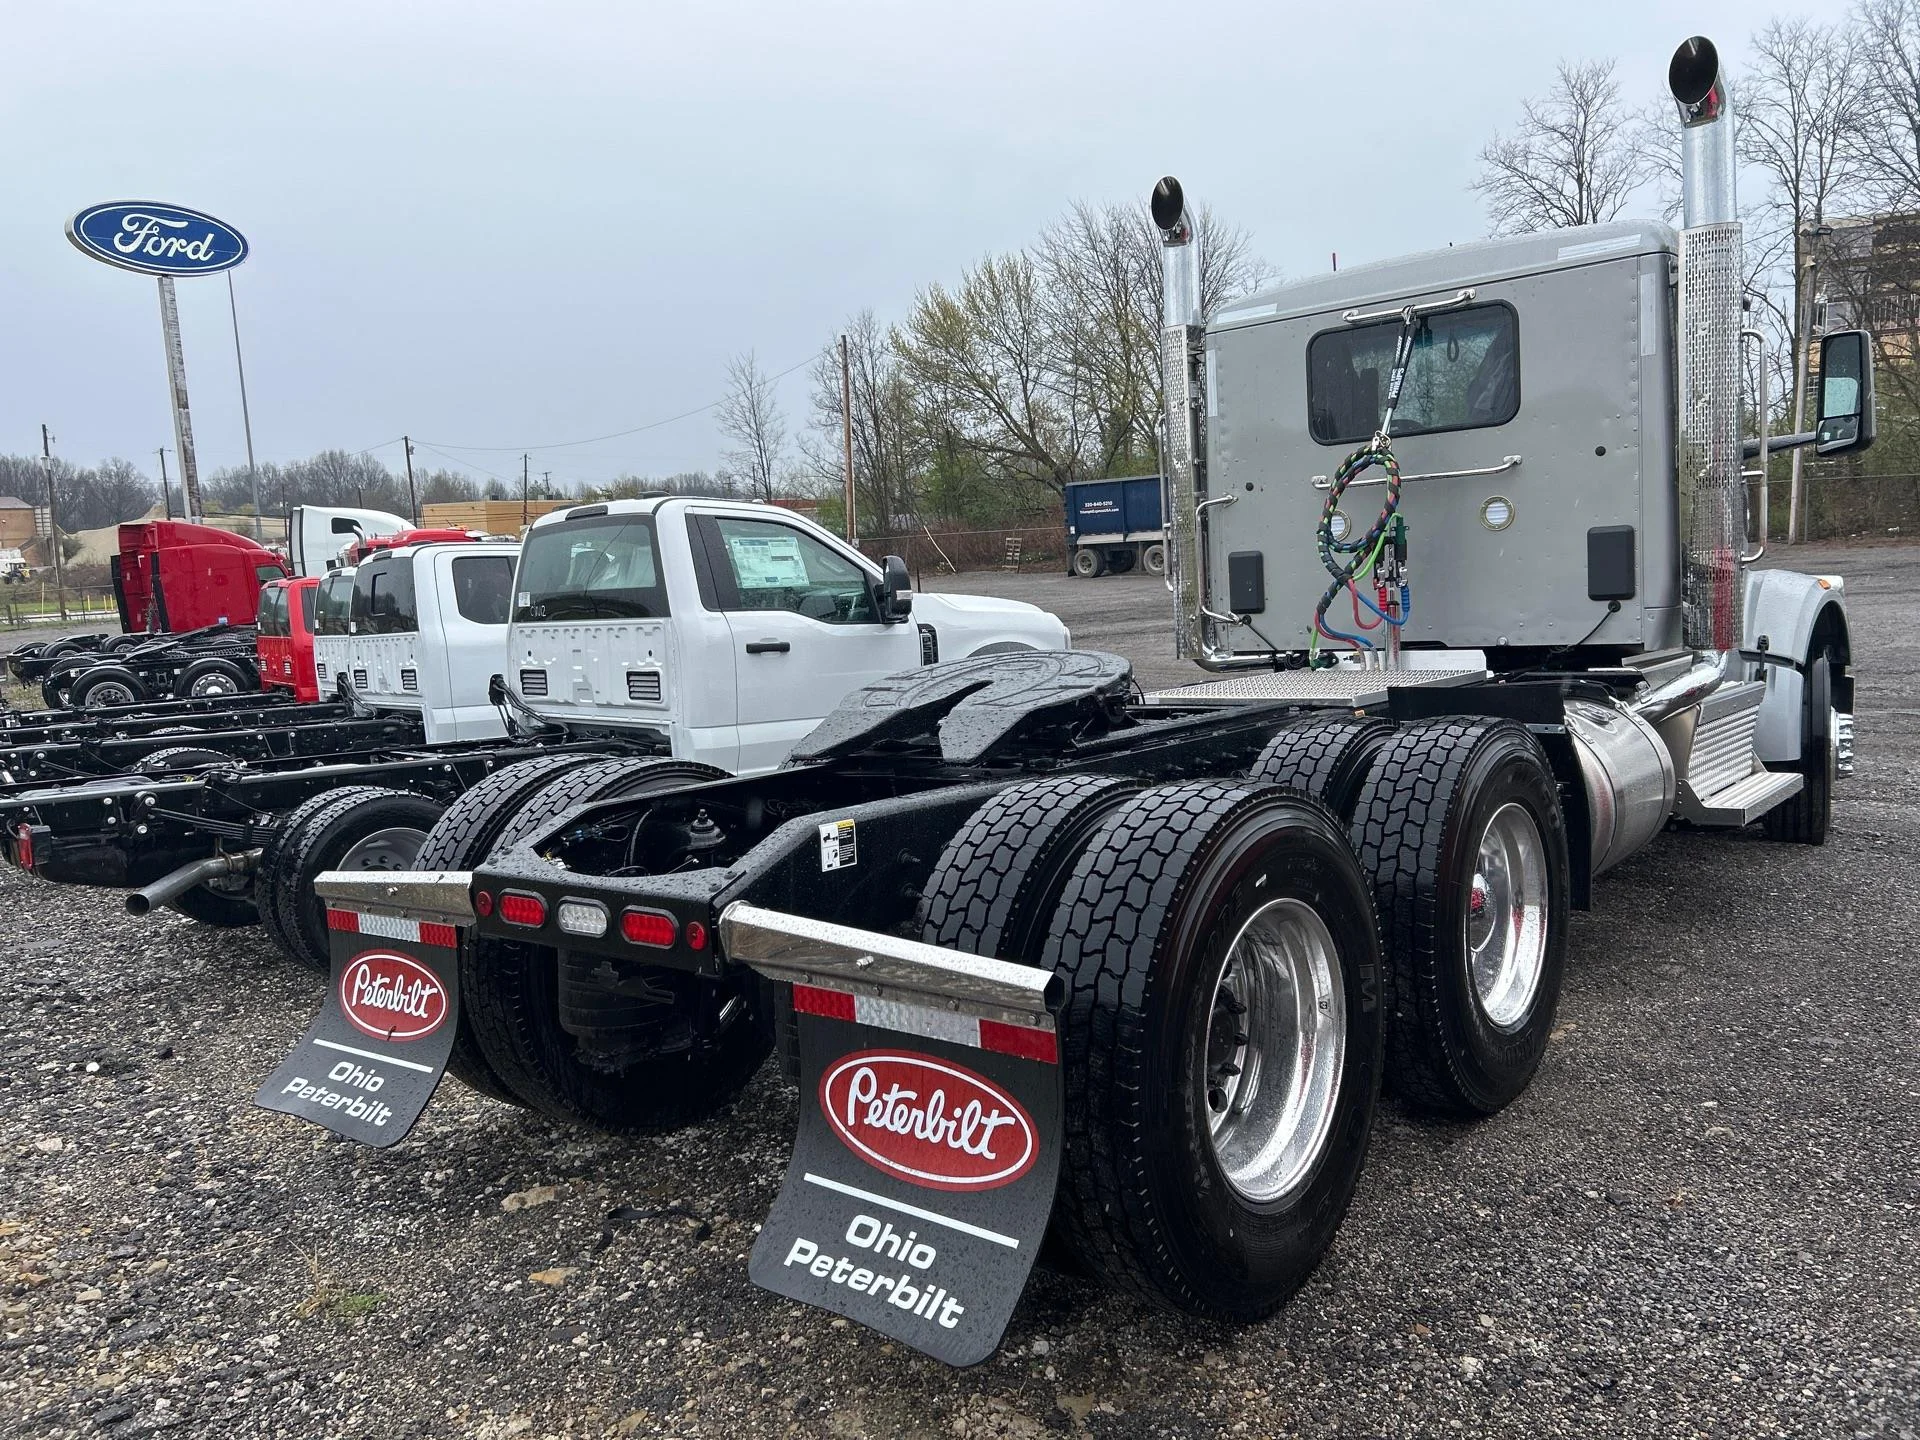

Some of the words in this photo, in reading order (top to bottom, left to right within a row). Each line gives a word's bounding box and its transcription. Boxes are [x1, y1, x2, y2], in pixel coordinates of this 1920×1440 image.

[113, 213, 215, 261] Ford
[352, 963, 438, 1018] Peterbilt
[281, 1077, 392, 1127] Peterbilt
[328, 1061, 385, 1092] Ohio
[847, 1067, 1016, 1160] Peterbilt
[845, 1214, 937, 1270] Ohio
[783, 1237, 965, 1329] Peterbilt
